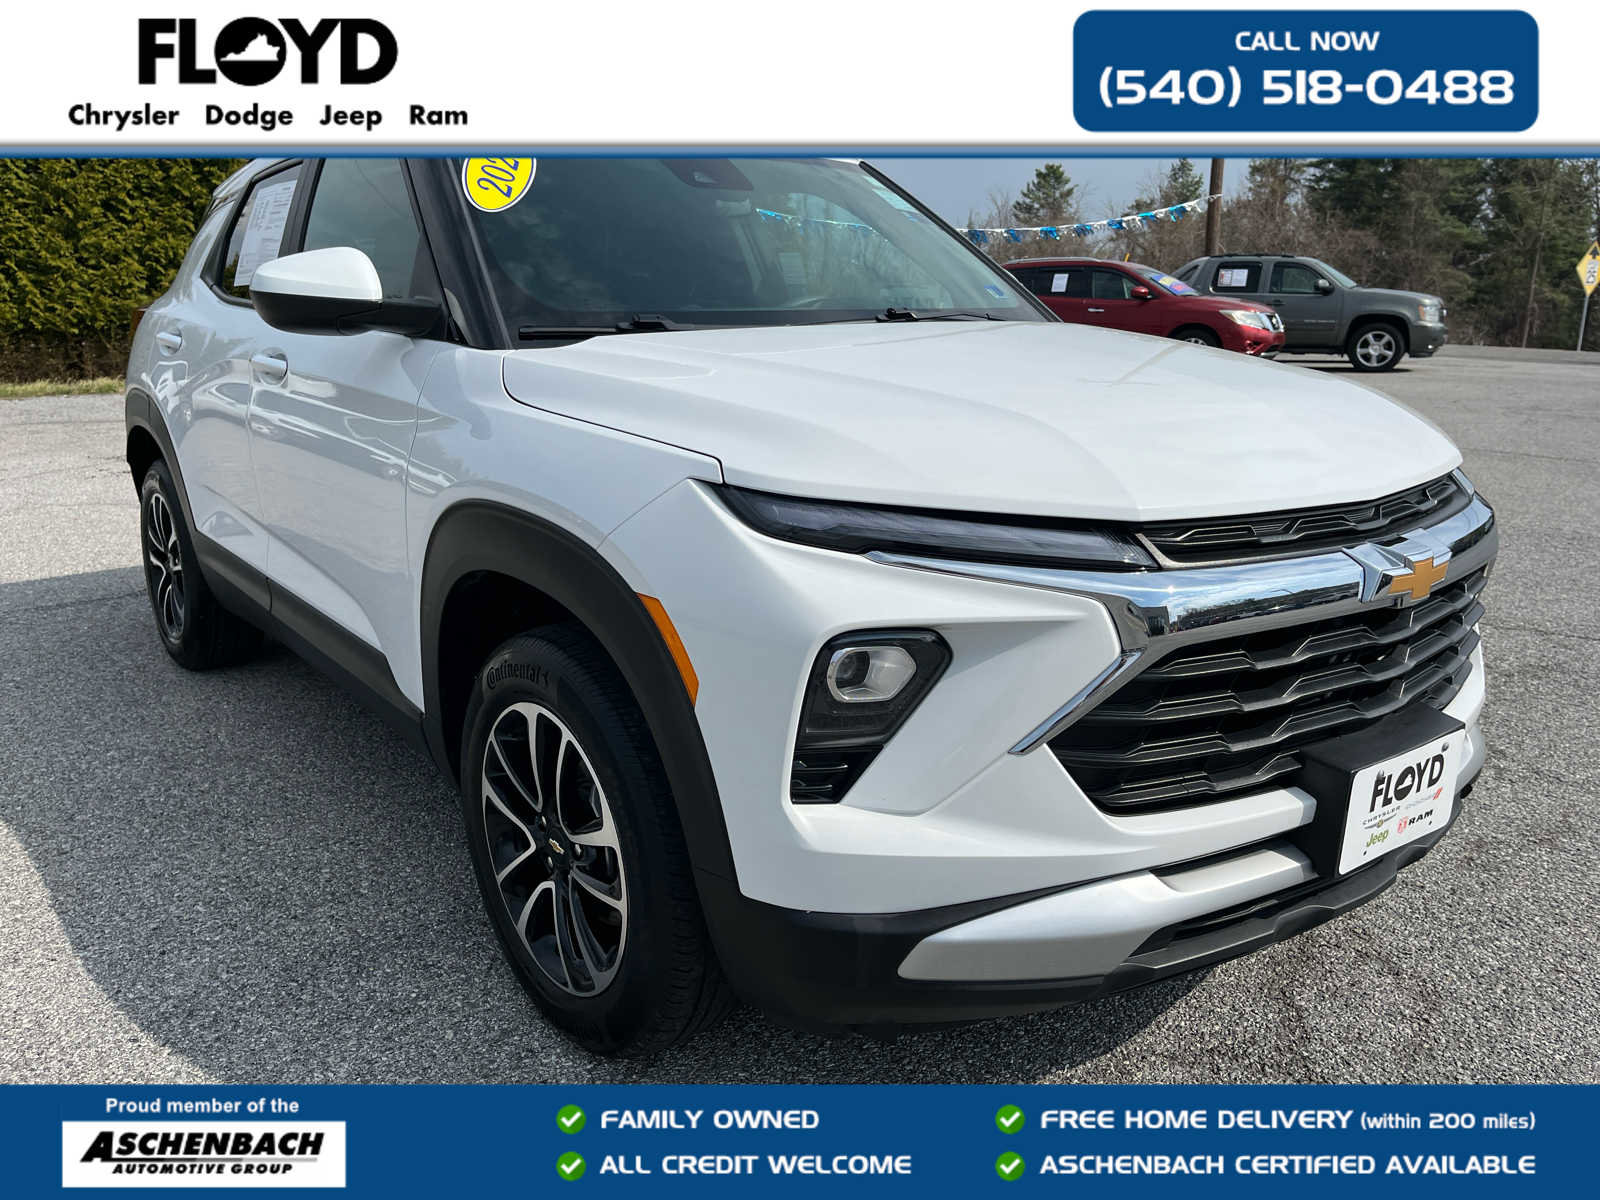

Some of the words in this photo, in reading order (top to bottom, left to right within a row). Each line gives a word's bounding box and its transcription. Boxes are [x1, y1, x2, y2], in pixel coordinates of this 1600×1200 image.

[486, 659, 542, 690] Continental
[1369, 753, 1445, 813] FLOYD
[1362, 805, 1401, 825] CHRYSLER
[1408, 809, 1433, 826] RAM
[1366, 829, 1389, 848] Jeep
